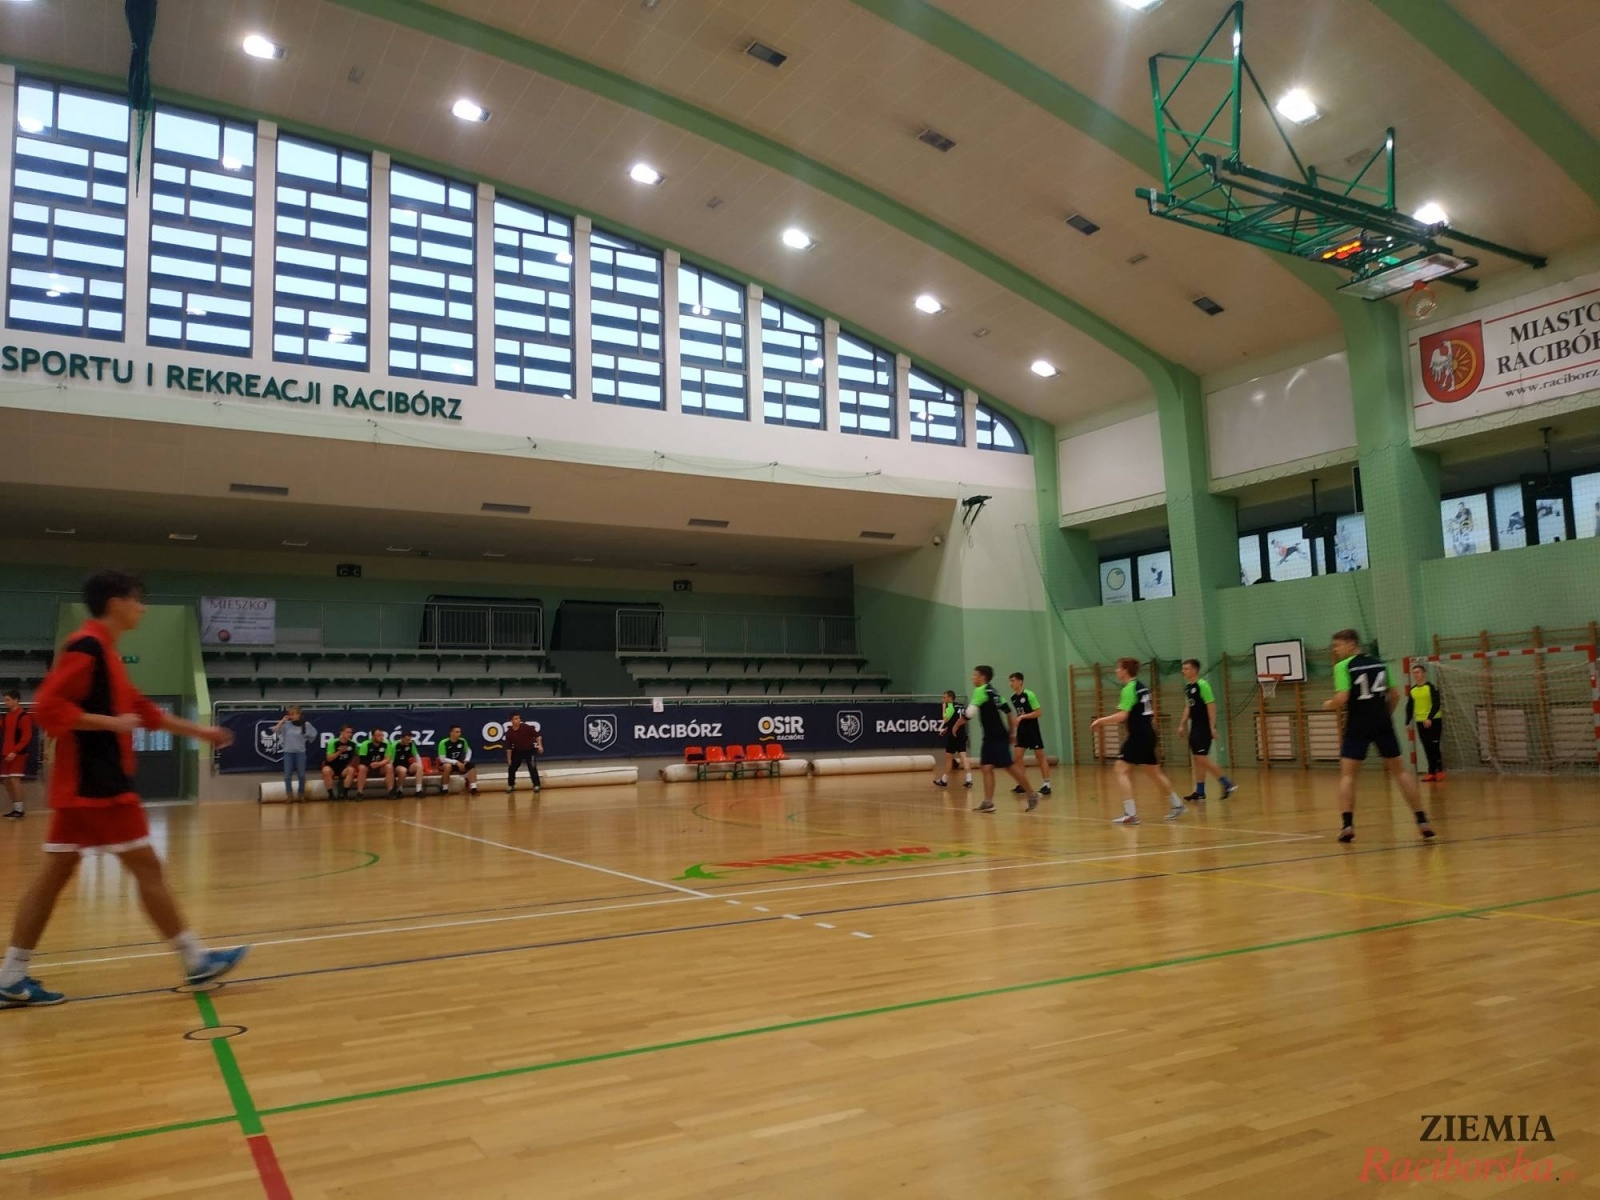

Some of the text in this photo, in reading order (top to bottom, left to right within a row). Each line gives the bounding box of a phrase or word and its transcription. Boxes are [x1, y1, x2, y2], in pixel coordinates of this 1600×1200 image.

[1509, 302, 1600, 345] MIASTO
[2, 345, 462, 420] SPORTU I REKREACJI RACIBÓRZ
[1353, 670, 1387, 700] 14
[634, 719, 722, 739] RACIBÓRZ
[758, 716, 804, 734] OSiR
[876, 715, 945, 733] RACIBÓRZ
